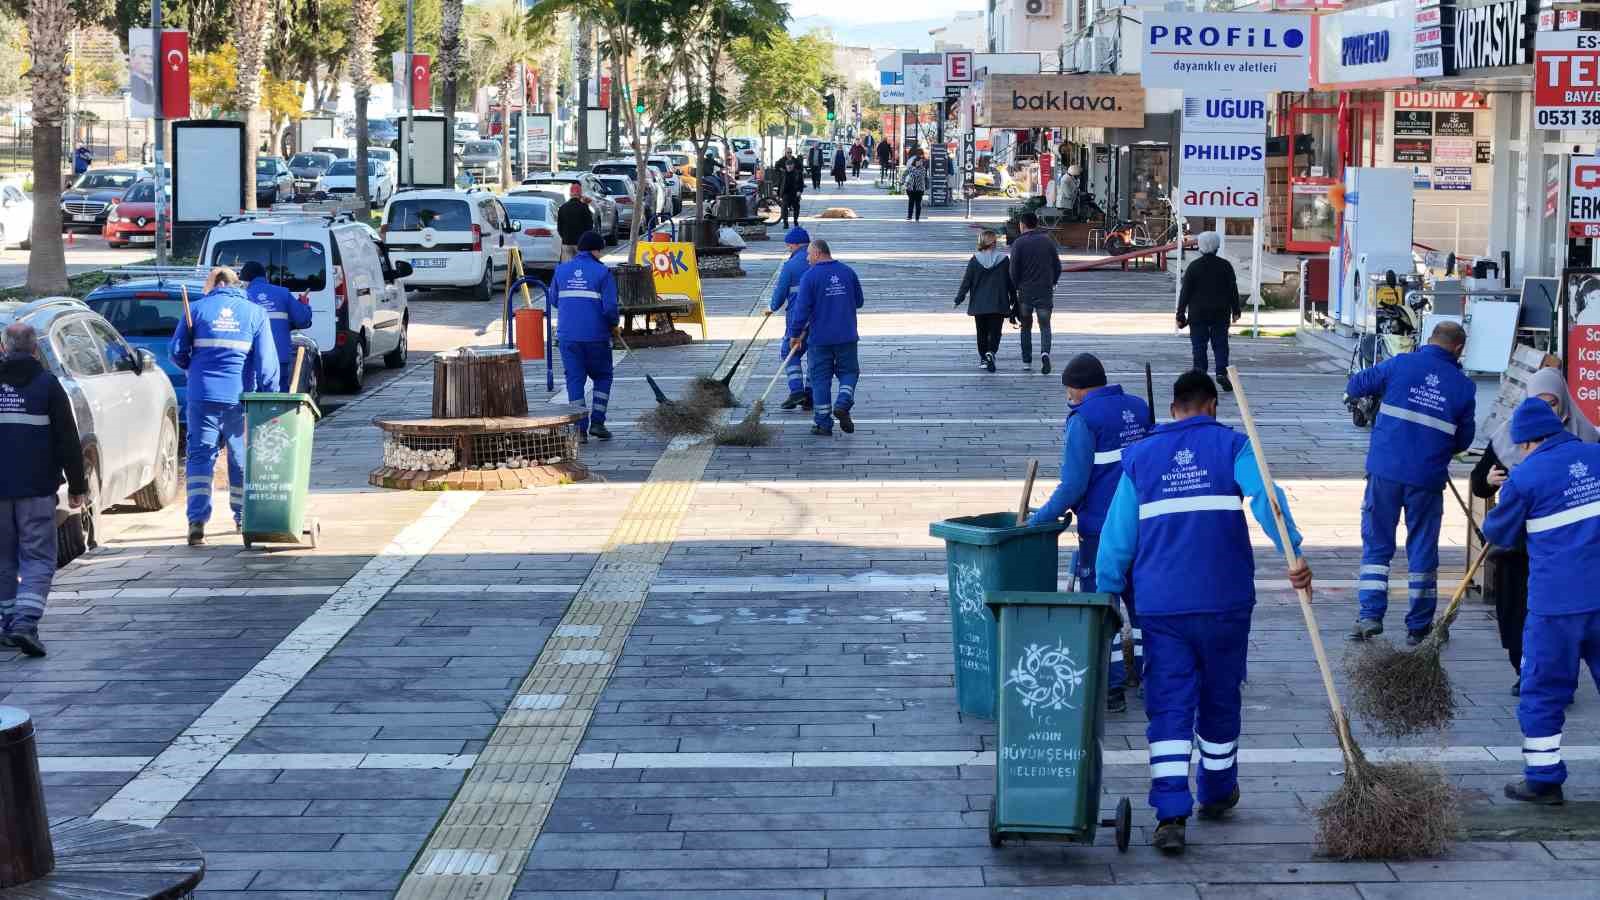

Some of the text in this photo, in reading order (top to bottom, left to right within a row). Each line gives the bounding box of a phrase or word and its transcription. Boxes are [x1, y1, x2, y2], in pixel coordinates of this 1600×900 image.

[1224, 64, 1238, 72] ev
[1239, 61, 1277, 73] aletleri
[1012, 90, 1123, 111] baklava.
[1538, 110, 1576, 126] 0531
[1184, 144, 1263, 161] PHILIPS
[1184, 187, 1259, 207] arnica
